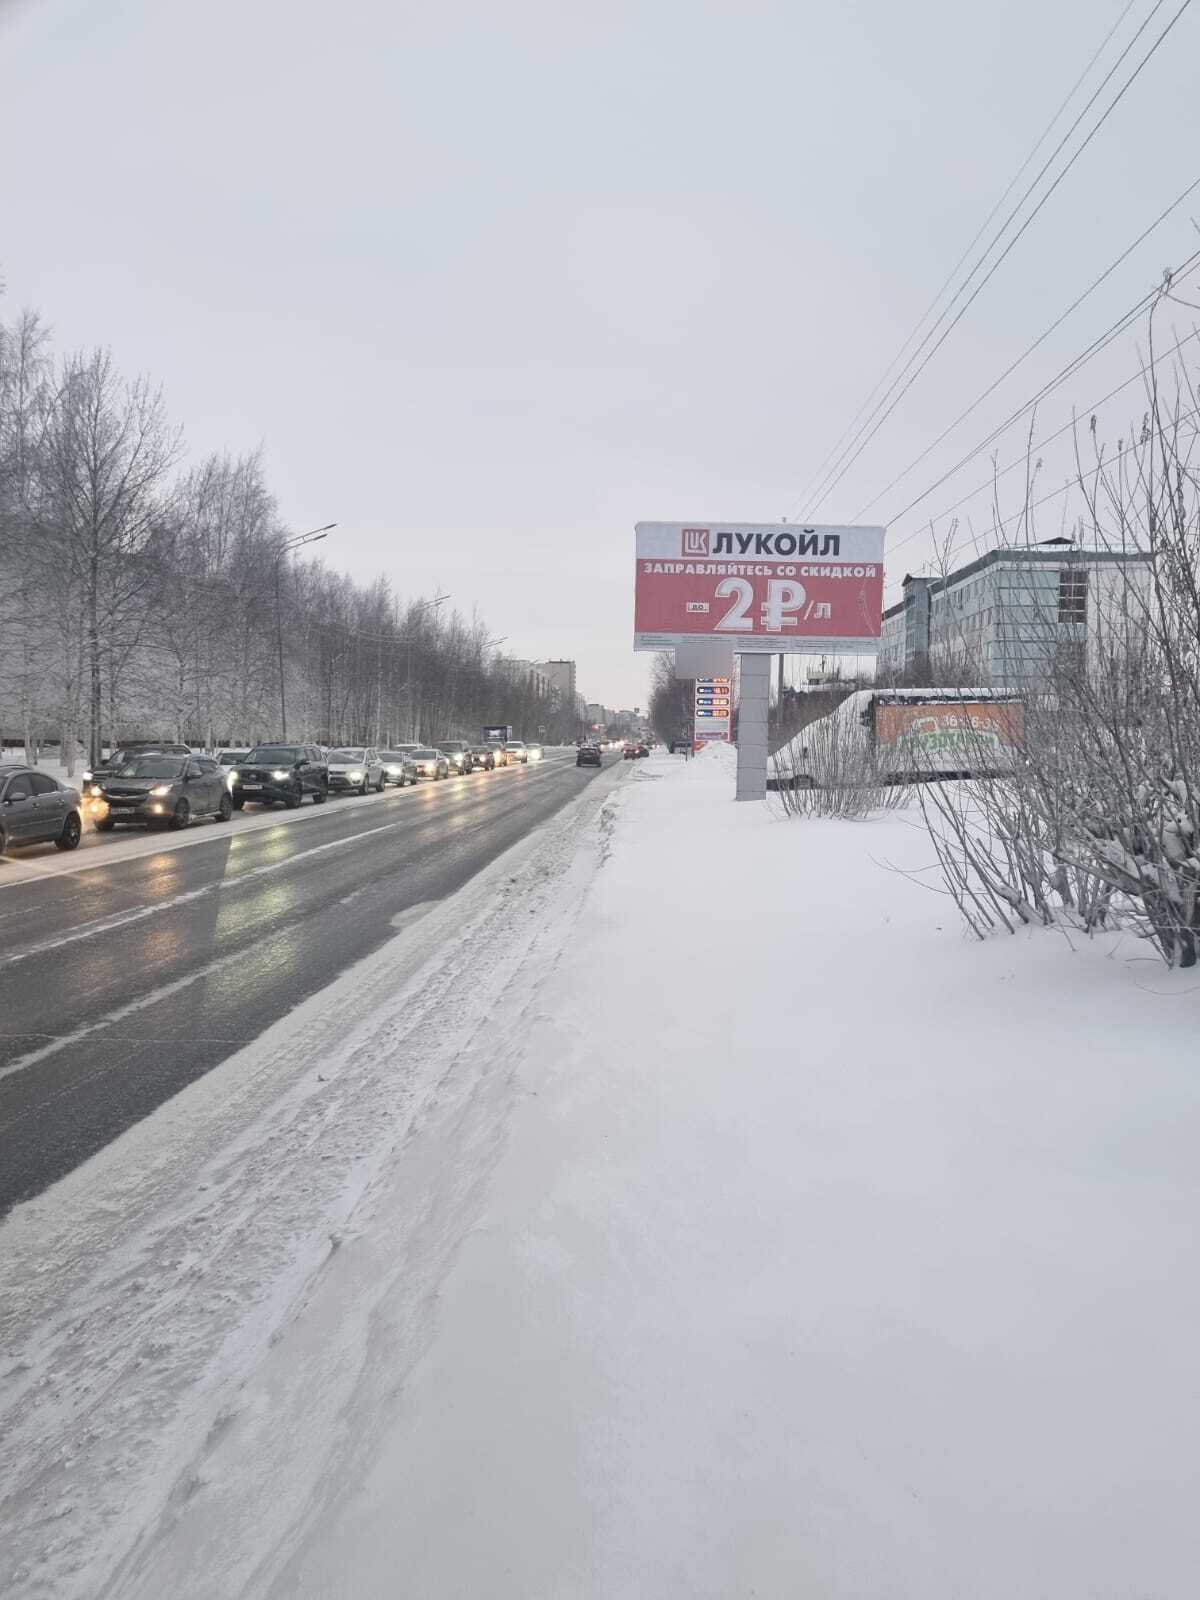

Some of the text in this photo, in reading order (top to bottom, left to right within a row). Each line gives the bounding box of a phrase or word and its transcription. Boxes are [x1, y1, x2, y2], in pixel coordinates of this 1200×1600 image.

[712, 529, 840, 556] ЛУКОЙЛ
[643, 562, 876, 578] ЗАПРАВЛЯЙТЕСЬ СО СКИДКОЙ
